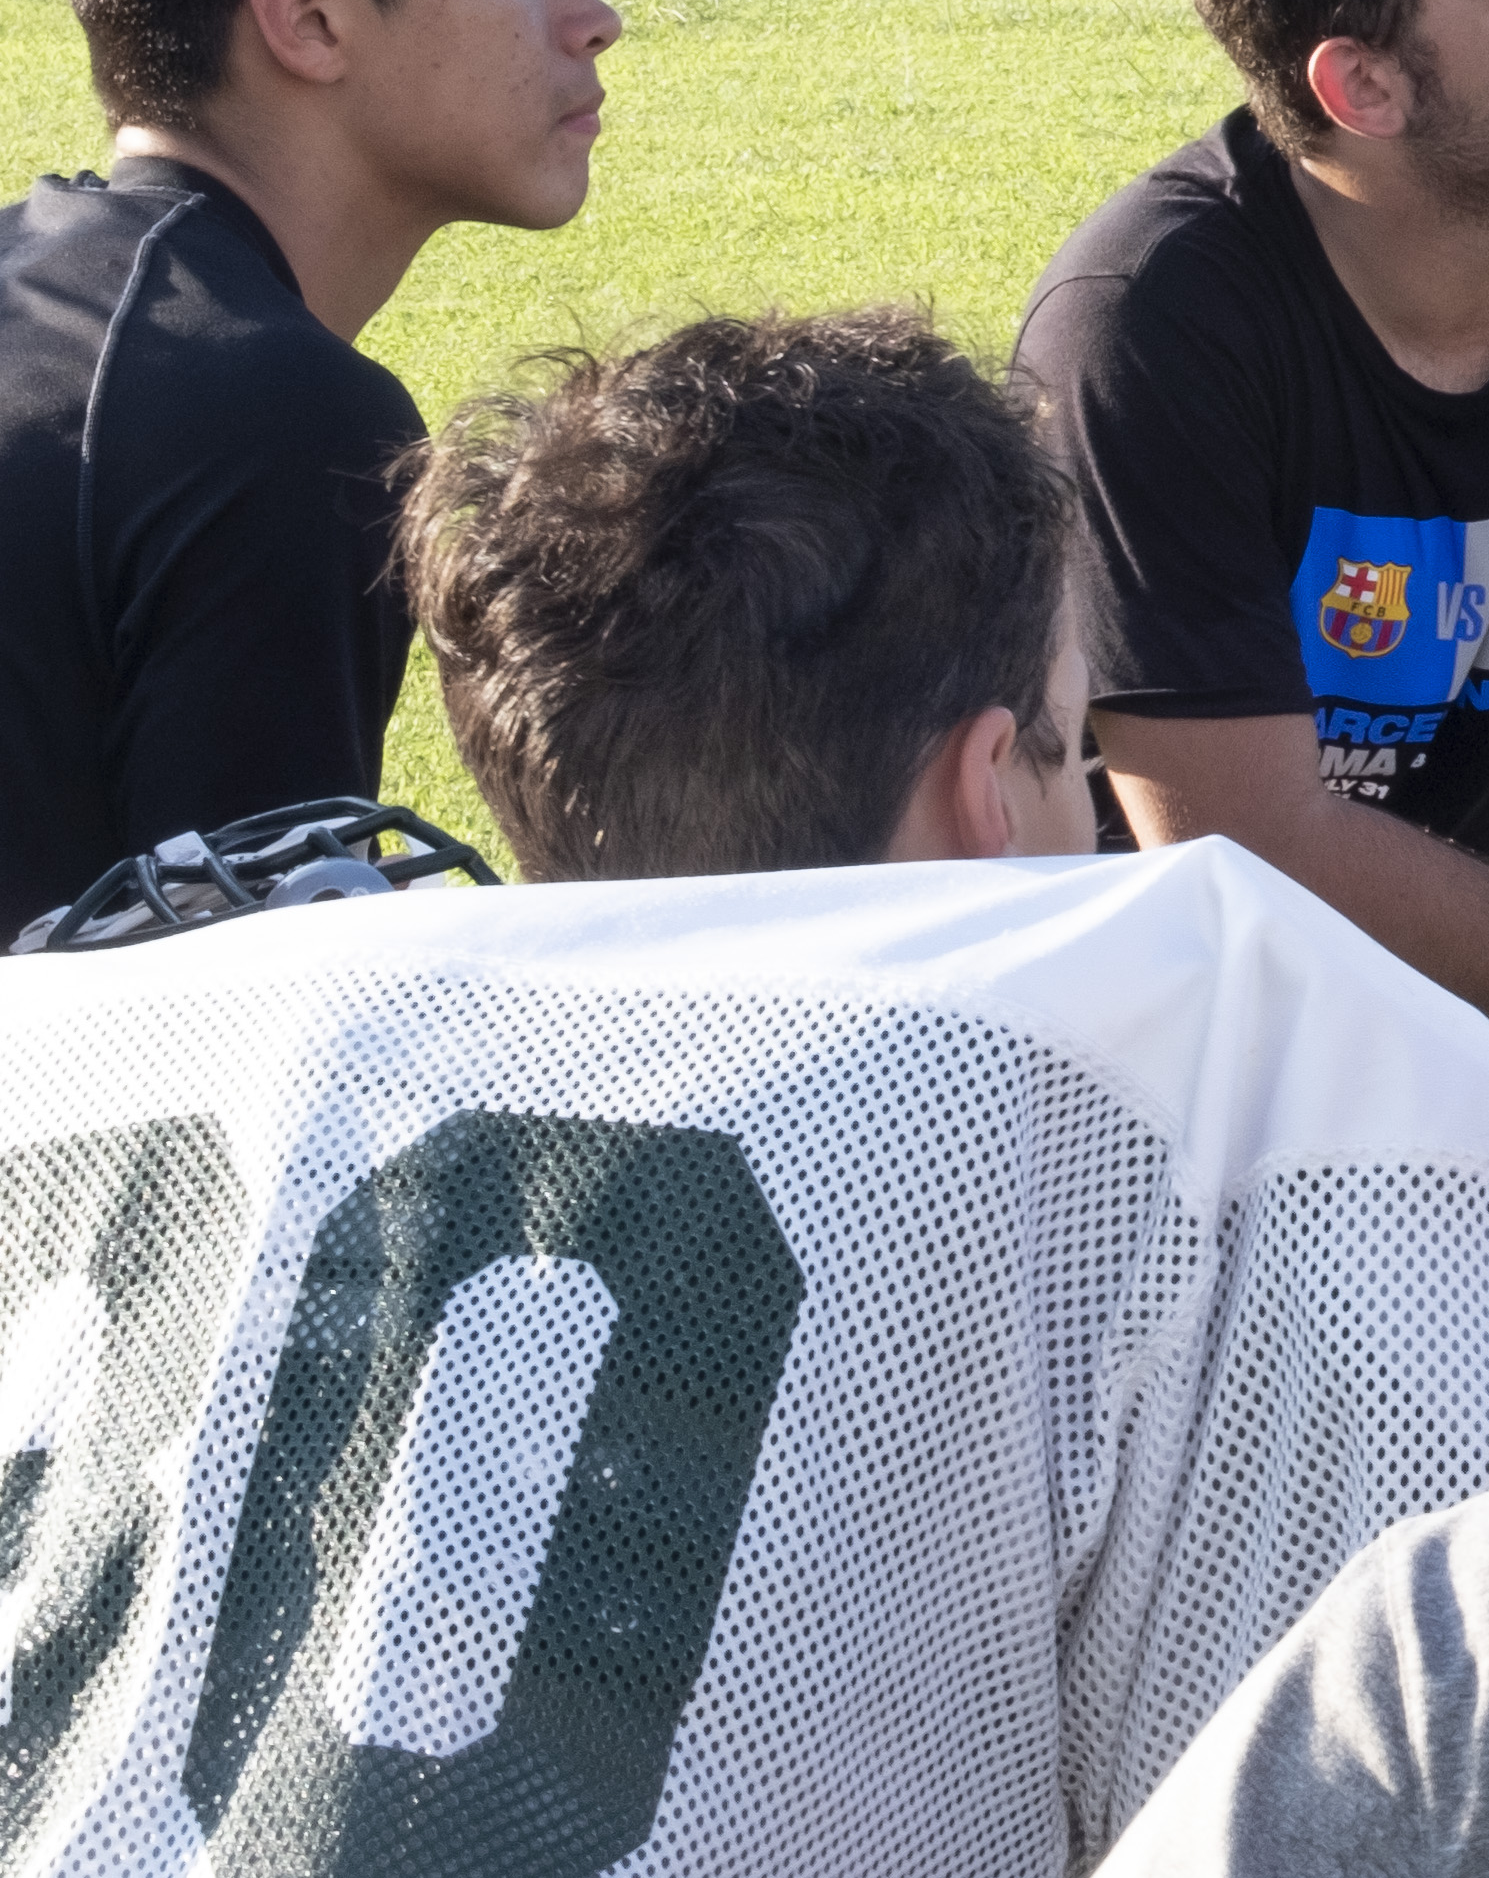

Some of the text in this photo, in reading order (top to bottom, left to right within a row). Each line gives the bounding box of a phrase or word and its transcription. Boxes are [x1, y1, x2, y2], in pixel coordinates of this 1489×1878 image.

[1350, 603, 1387, 619] FCB
[1436, 581, 1486, 642] VS
[1319, 745, 1397, 778] MA
[1324, 779, 1390, 799] LY 31
